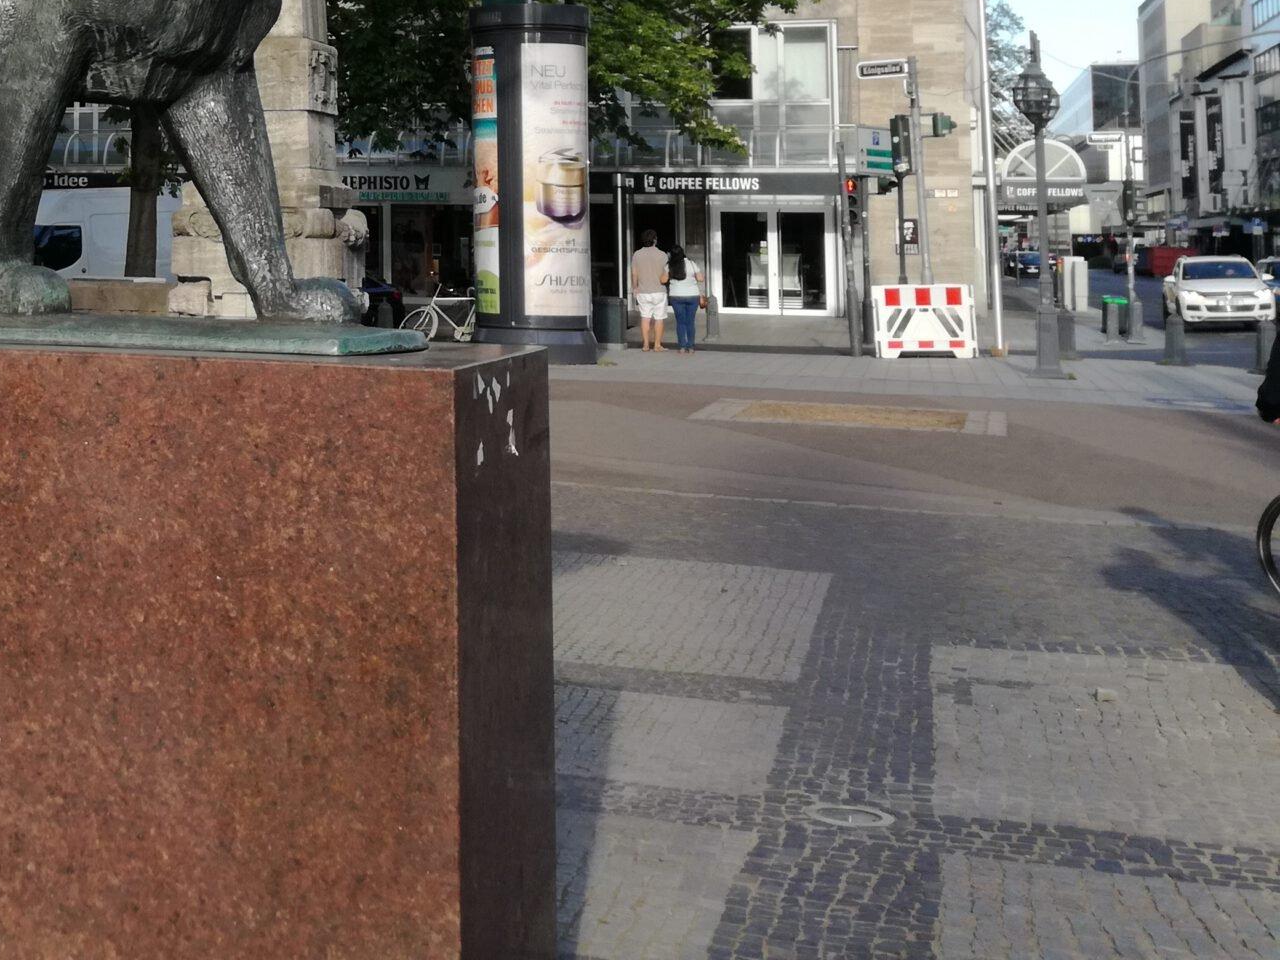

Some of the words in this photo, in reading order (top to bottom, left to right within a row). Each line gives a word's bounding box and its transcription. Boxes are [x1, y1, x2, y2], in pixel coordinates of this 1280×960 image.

[530, 64, 566, 78] NEU
[659, 177, 703, 190] COFFEE
[705, 177, 760, 190] FELLOWS
[1016, 187, 1038, 197] COFF
[1047, 187, 1084, 197] FELLOWS
